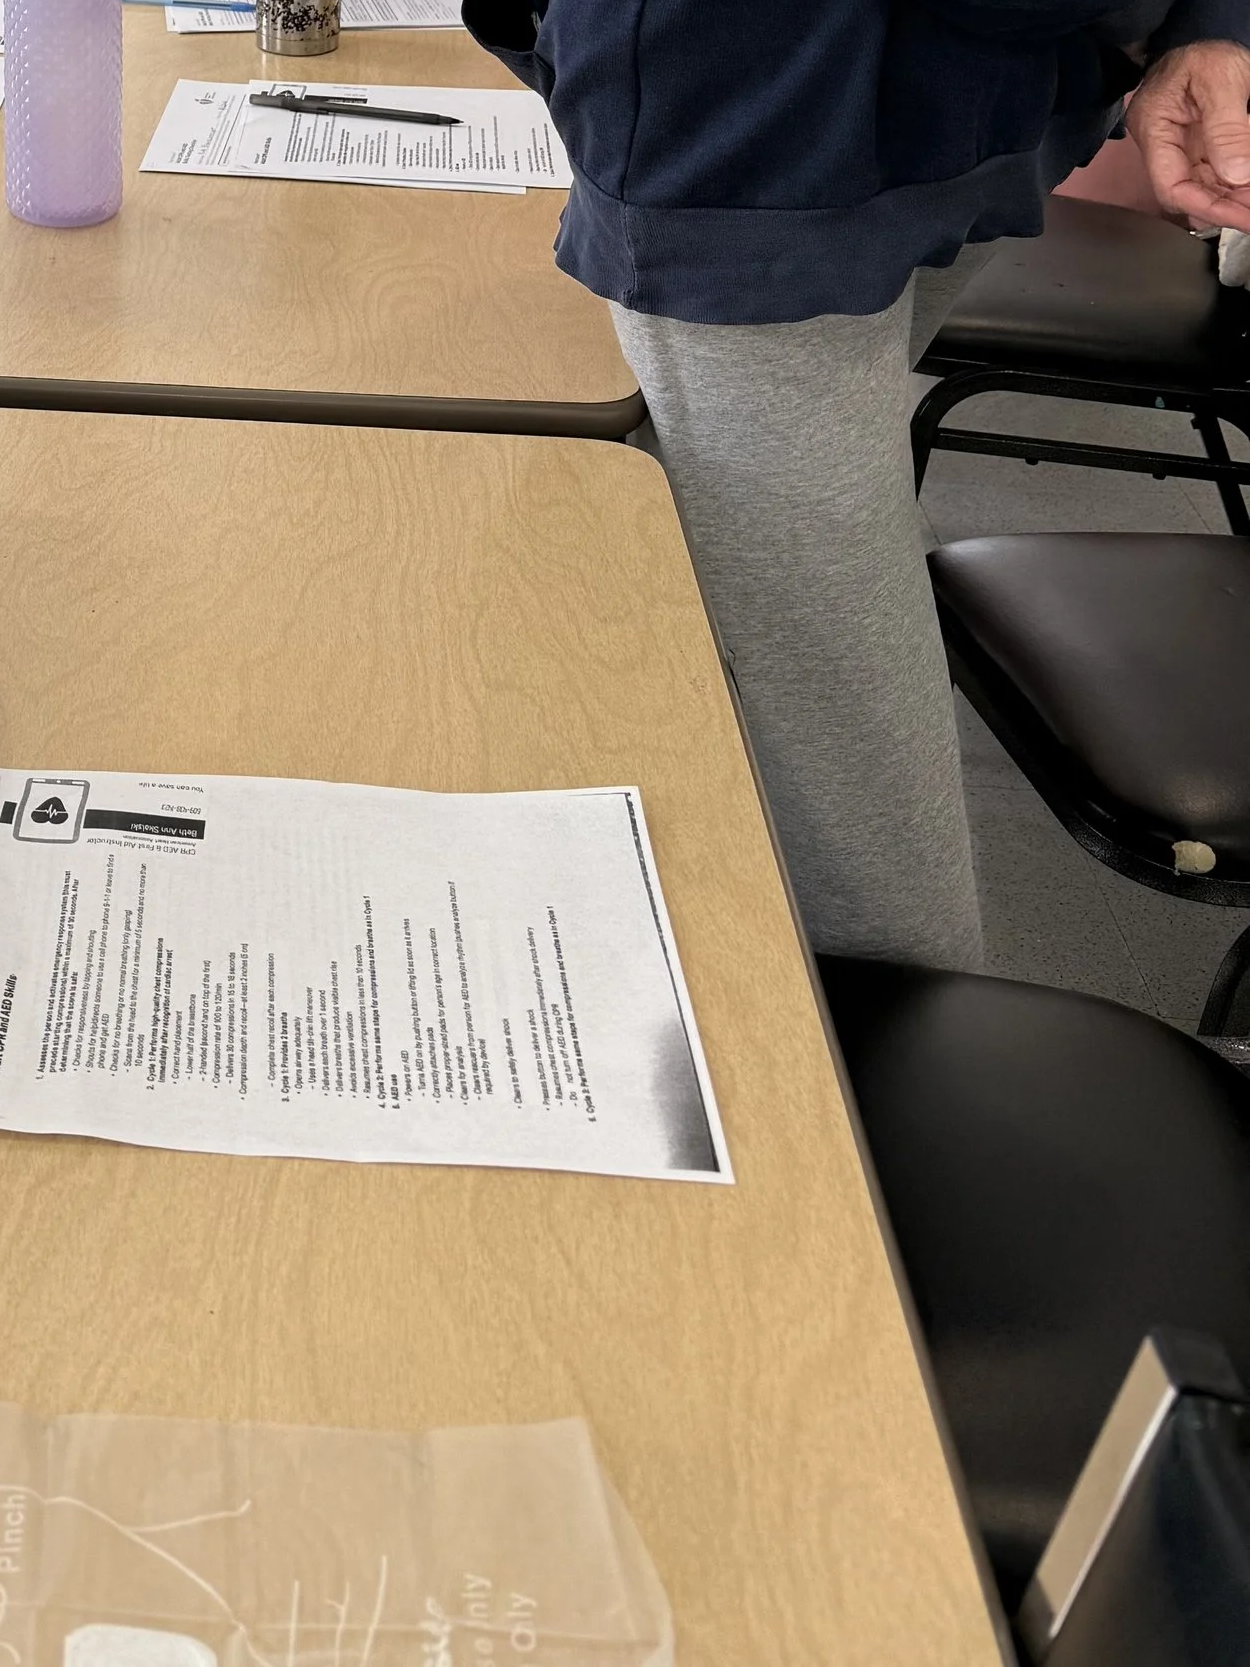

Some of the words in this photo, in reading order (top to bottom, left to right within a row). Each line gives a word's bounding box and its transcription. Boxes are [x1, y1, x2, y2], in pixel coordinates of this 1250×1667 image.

[161, 827, 177, 835] Ann
[178, 828, 197, 837] Beth
[86, 837, 122, 847] Instructor
[123, 840, 136, 849] Aid
[138, 843, 155, 851] First
[163, 845, 179, 854] AED
[180, 847, 196, 855] CPR
[3, 974, 17, 997] Skills
[0, 999, 13, 1016] AED
